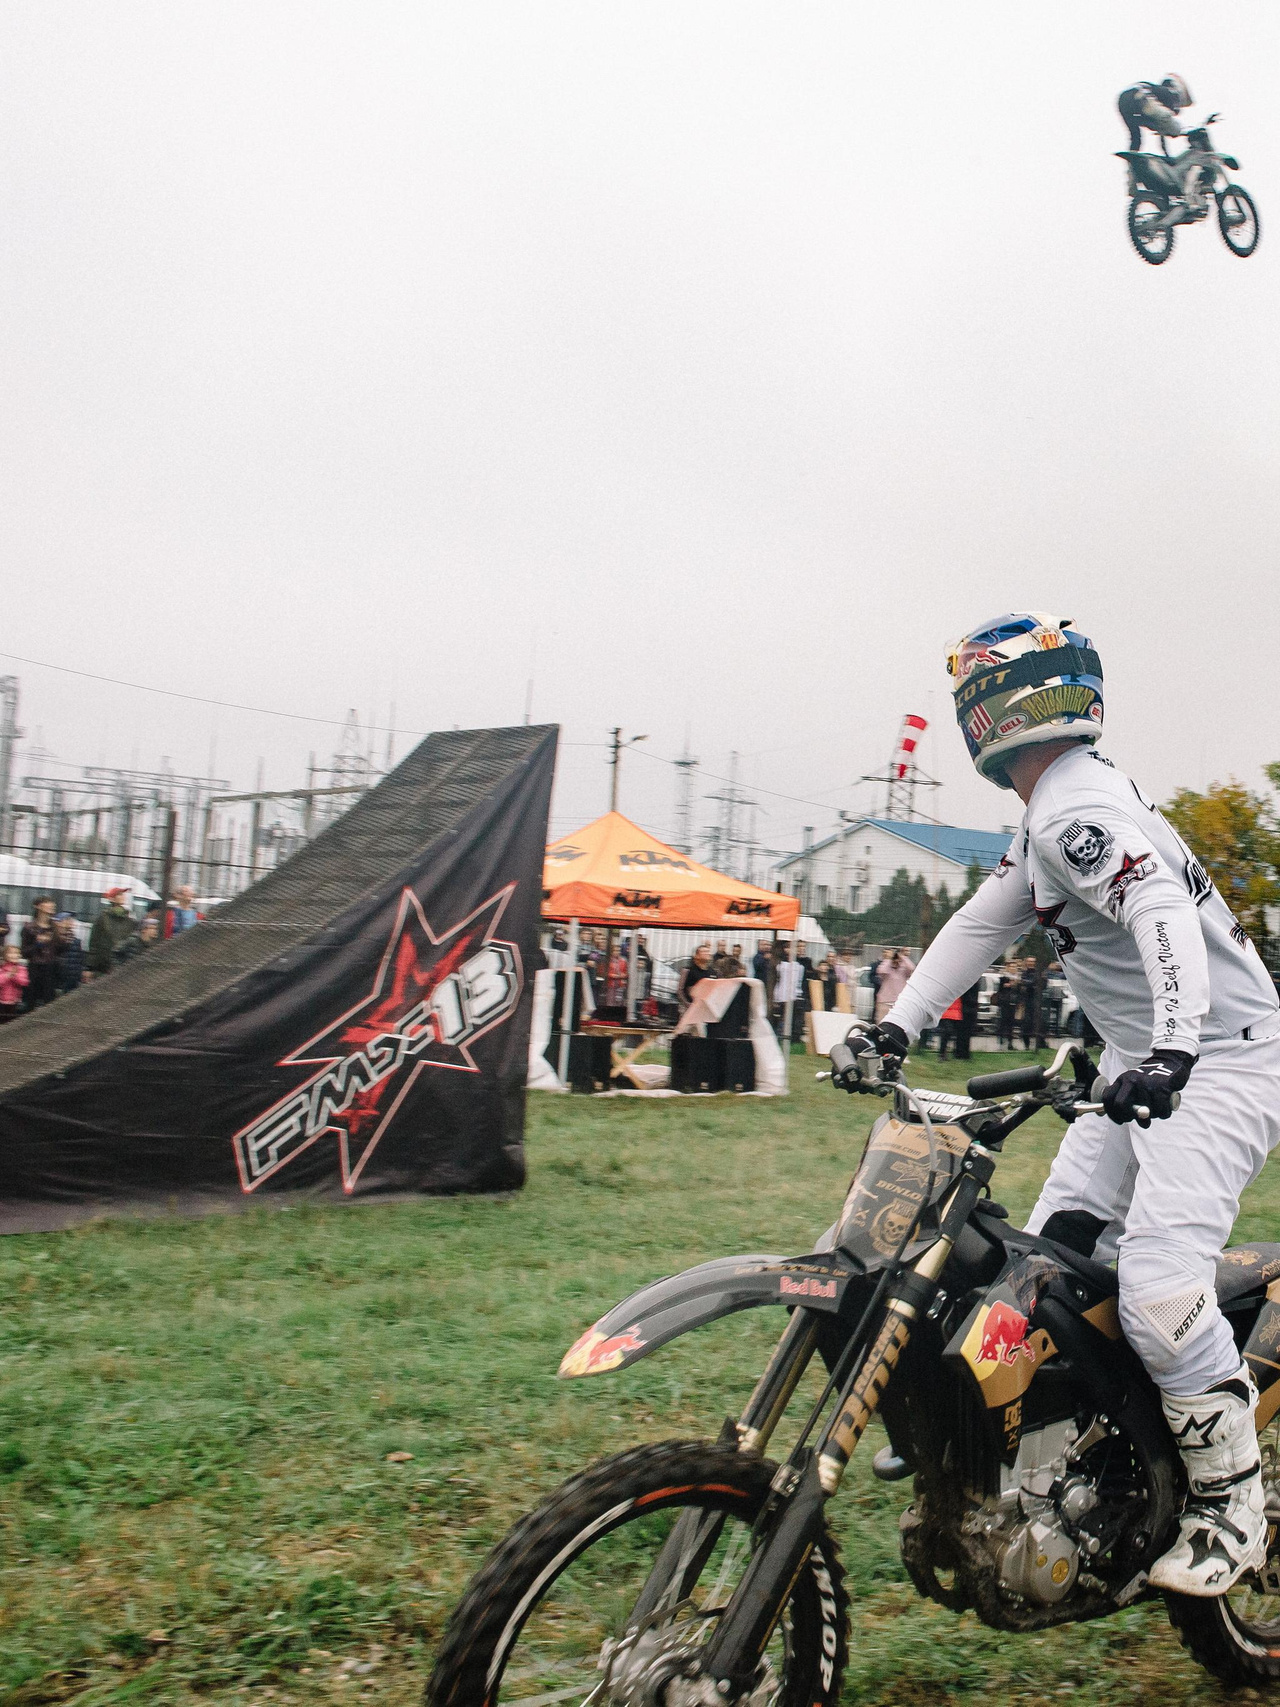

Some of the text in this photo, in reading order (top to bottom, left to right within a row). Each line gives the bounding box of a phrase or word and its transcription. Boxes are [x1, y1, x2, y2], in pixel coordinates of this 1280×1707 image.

[955, 669, 1011, 708] COTT
[969, 703, 993, 740] ull
[1000, 716, 1024, 733] BELL
[619, 850, 693, 871] KTM
[611, 889, 662, 908] KTM
[725, 898, 772, 916] KTM
[1155, 920, 1174, 963] Victory
[1161, 963, 1191, 992] Self
[876, 1180, 923, 1202] DUNLO
[780, 1275, 838, 1299] Red Bull
[854, 1315, 899, 1395] RACING
